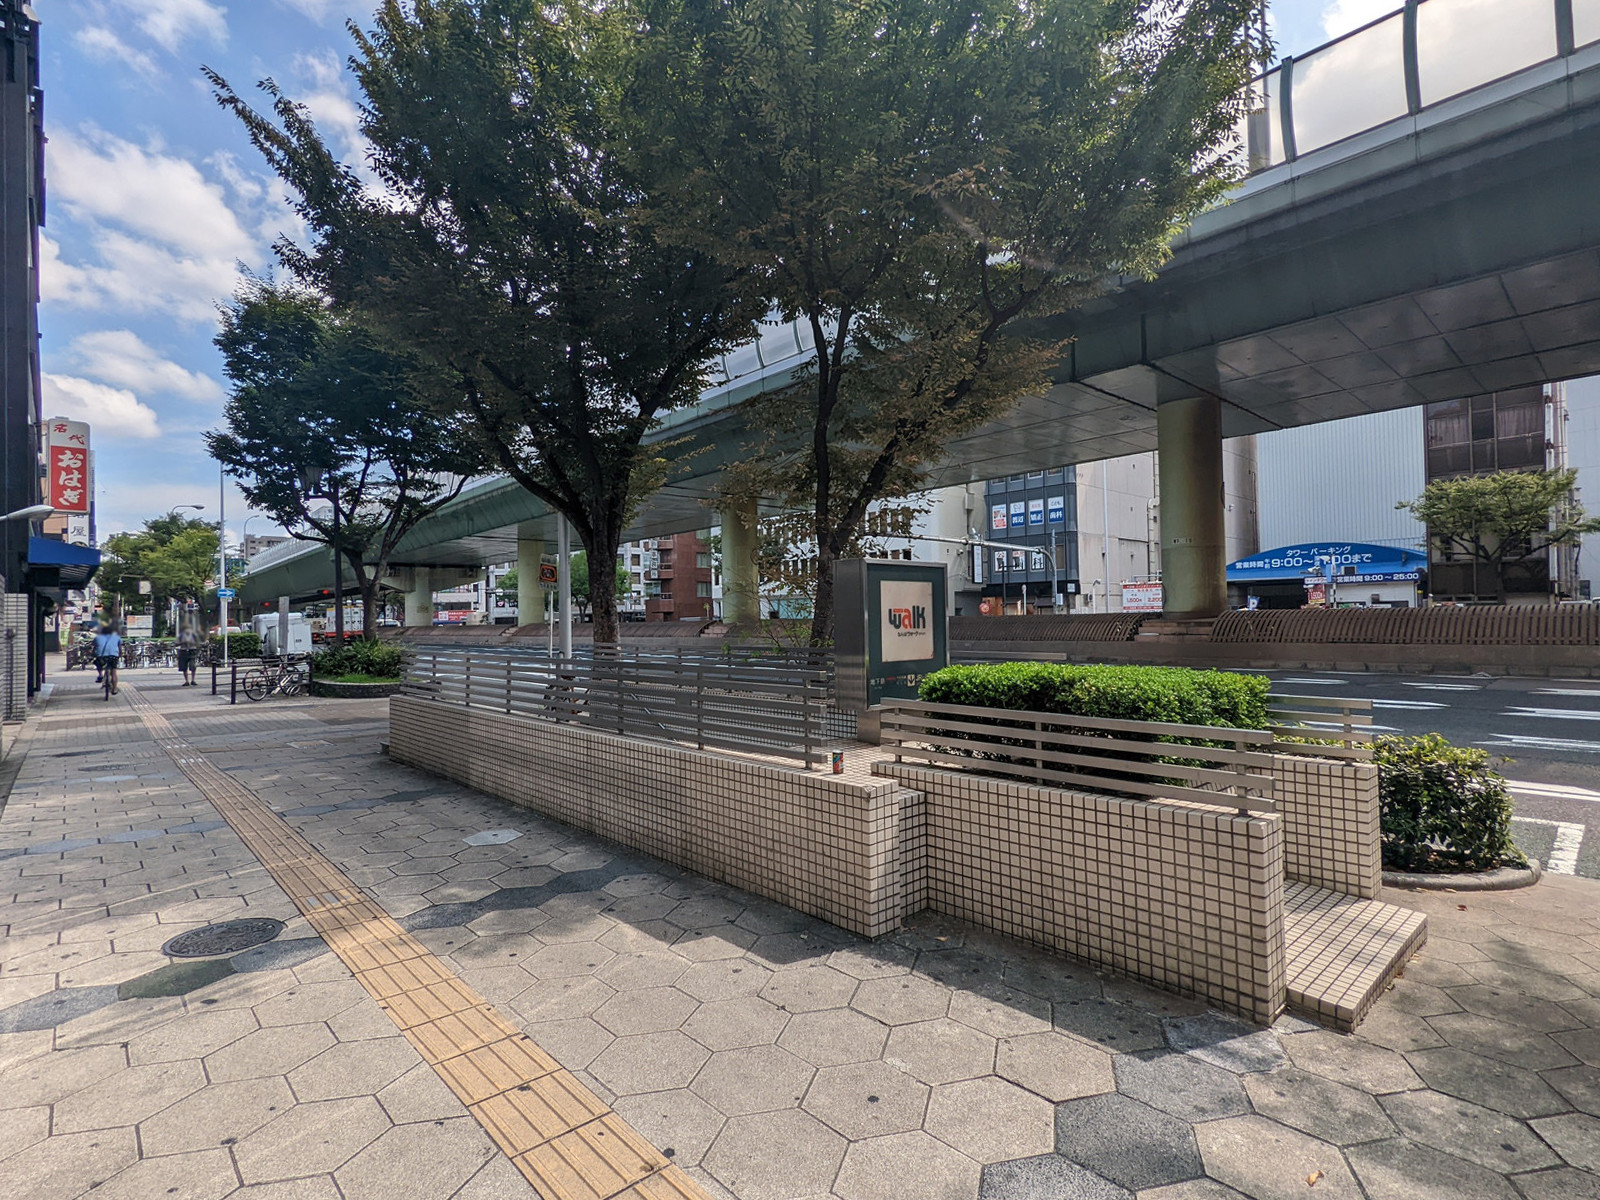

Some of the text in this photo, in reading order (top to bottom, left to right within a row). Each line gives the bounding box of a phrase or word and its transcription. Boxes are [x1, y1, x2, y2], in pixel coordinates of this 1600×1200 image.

[57, 450, 84, 506] おはぎ
[1393, 572, 1419, 580] 25:00
[888, 605, 926, 629] walk
